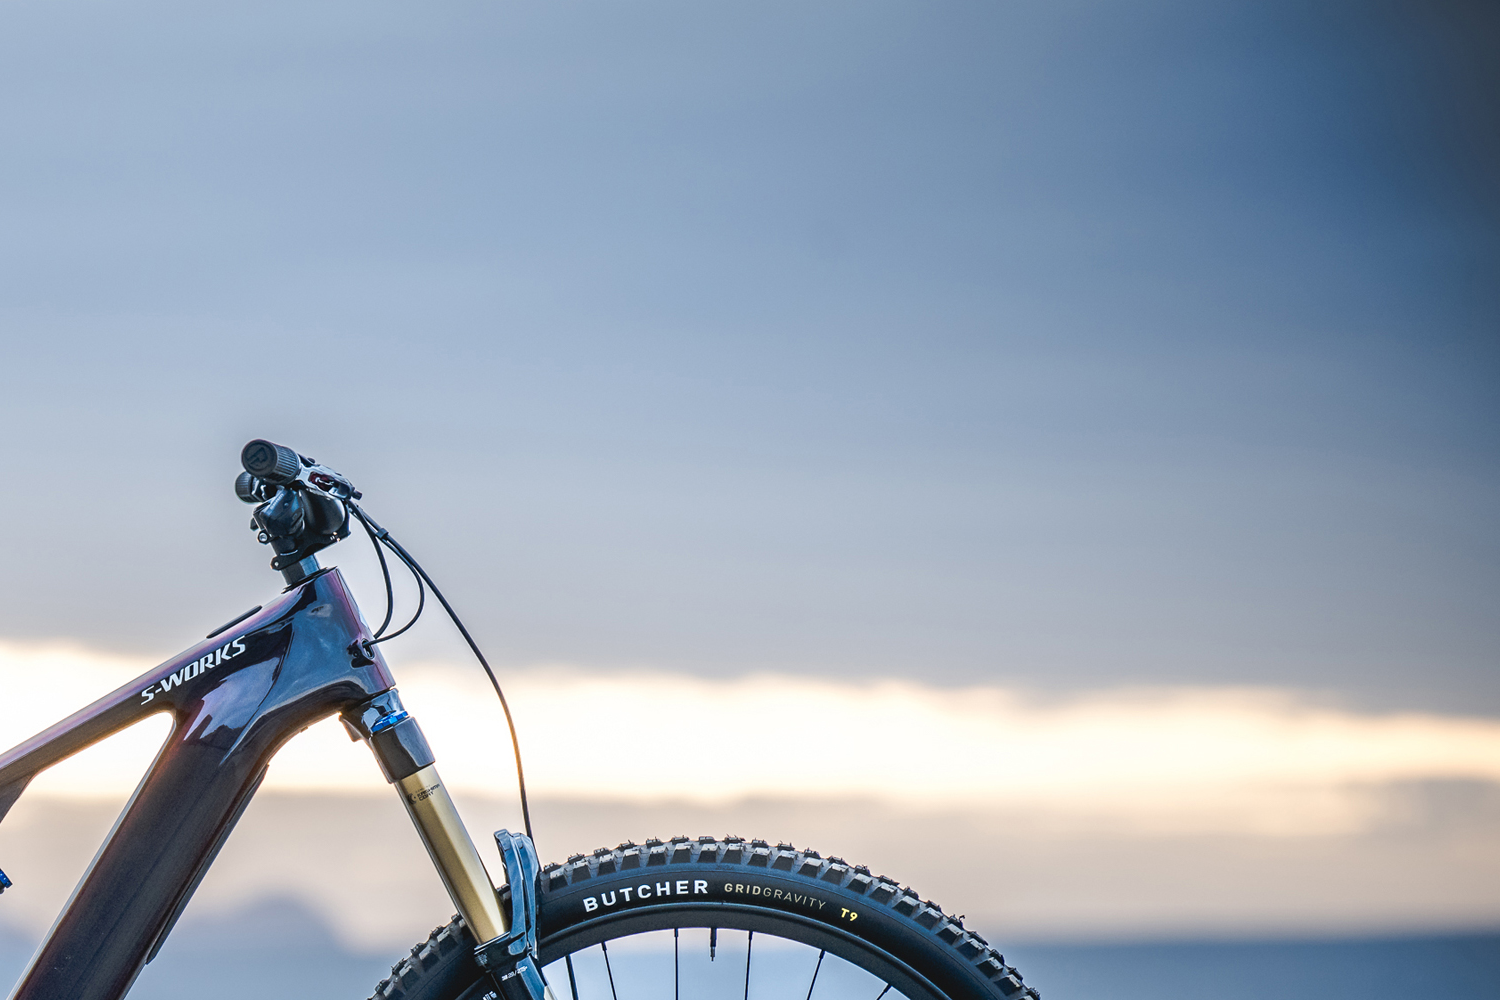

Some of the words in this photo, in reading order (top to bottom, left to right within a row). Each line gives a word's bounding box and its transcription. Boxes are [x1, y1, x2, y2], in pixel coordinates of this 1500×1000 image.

[140, 635, 246, 706] S-WORKS
[583, 879, 709, 913] BUTCHER
[840, 907, 859, 922] T9
